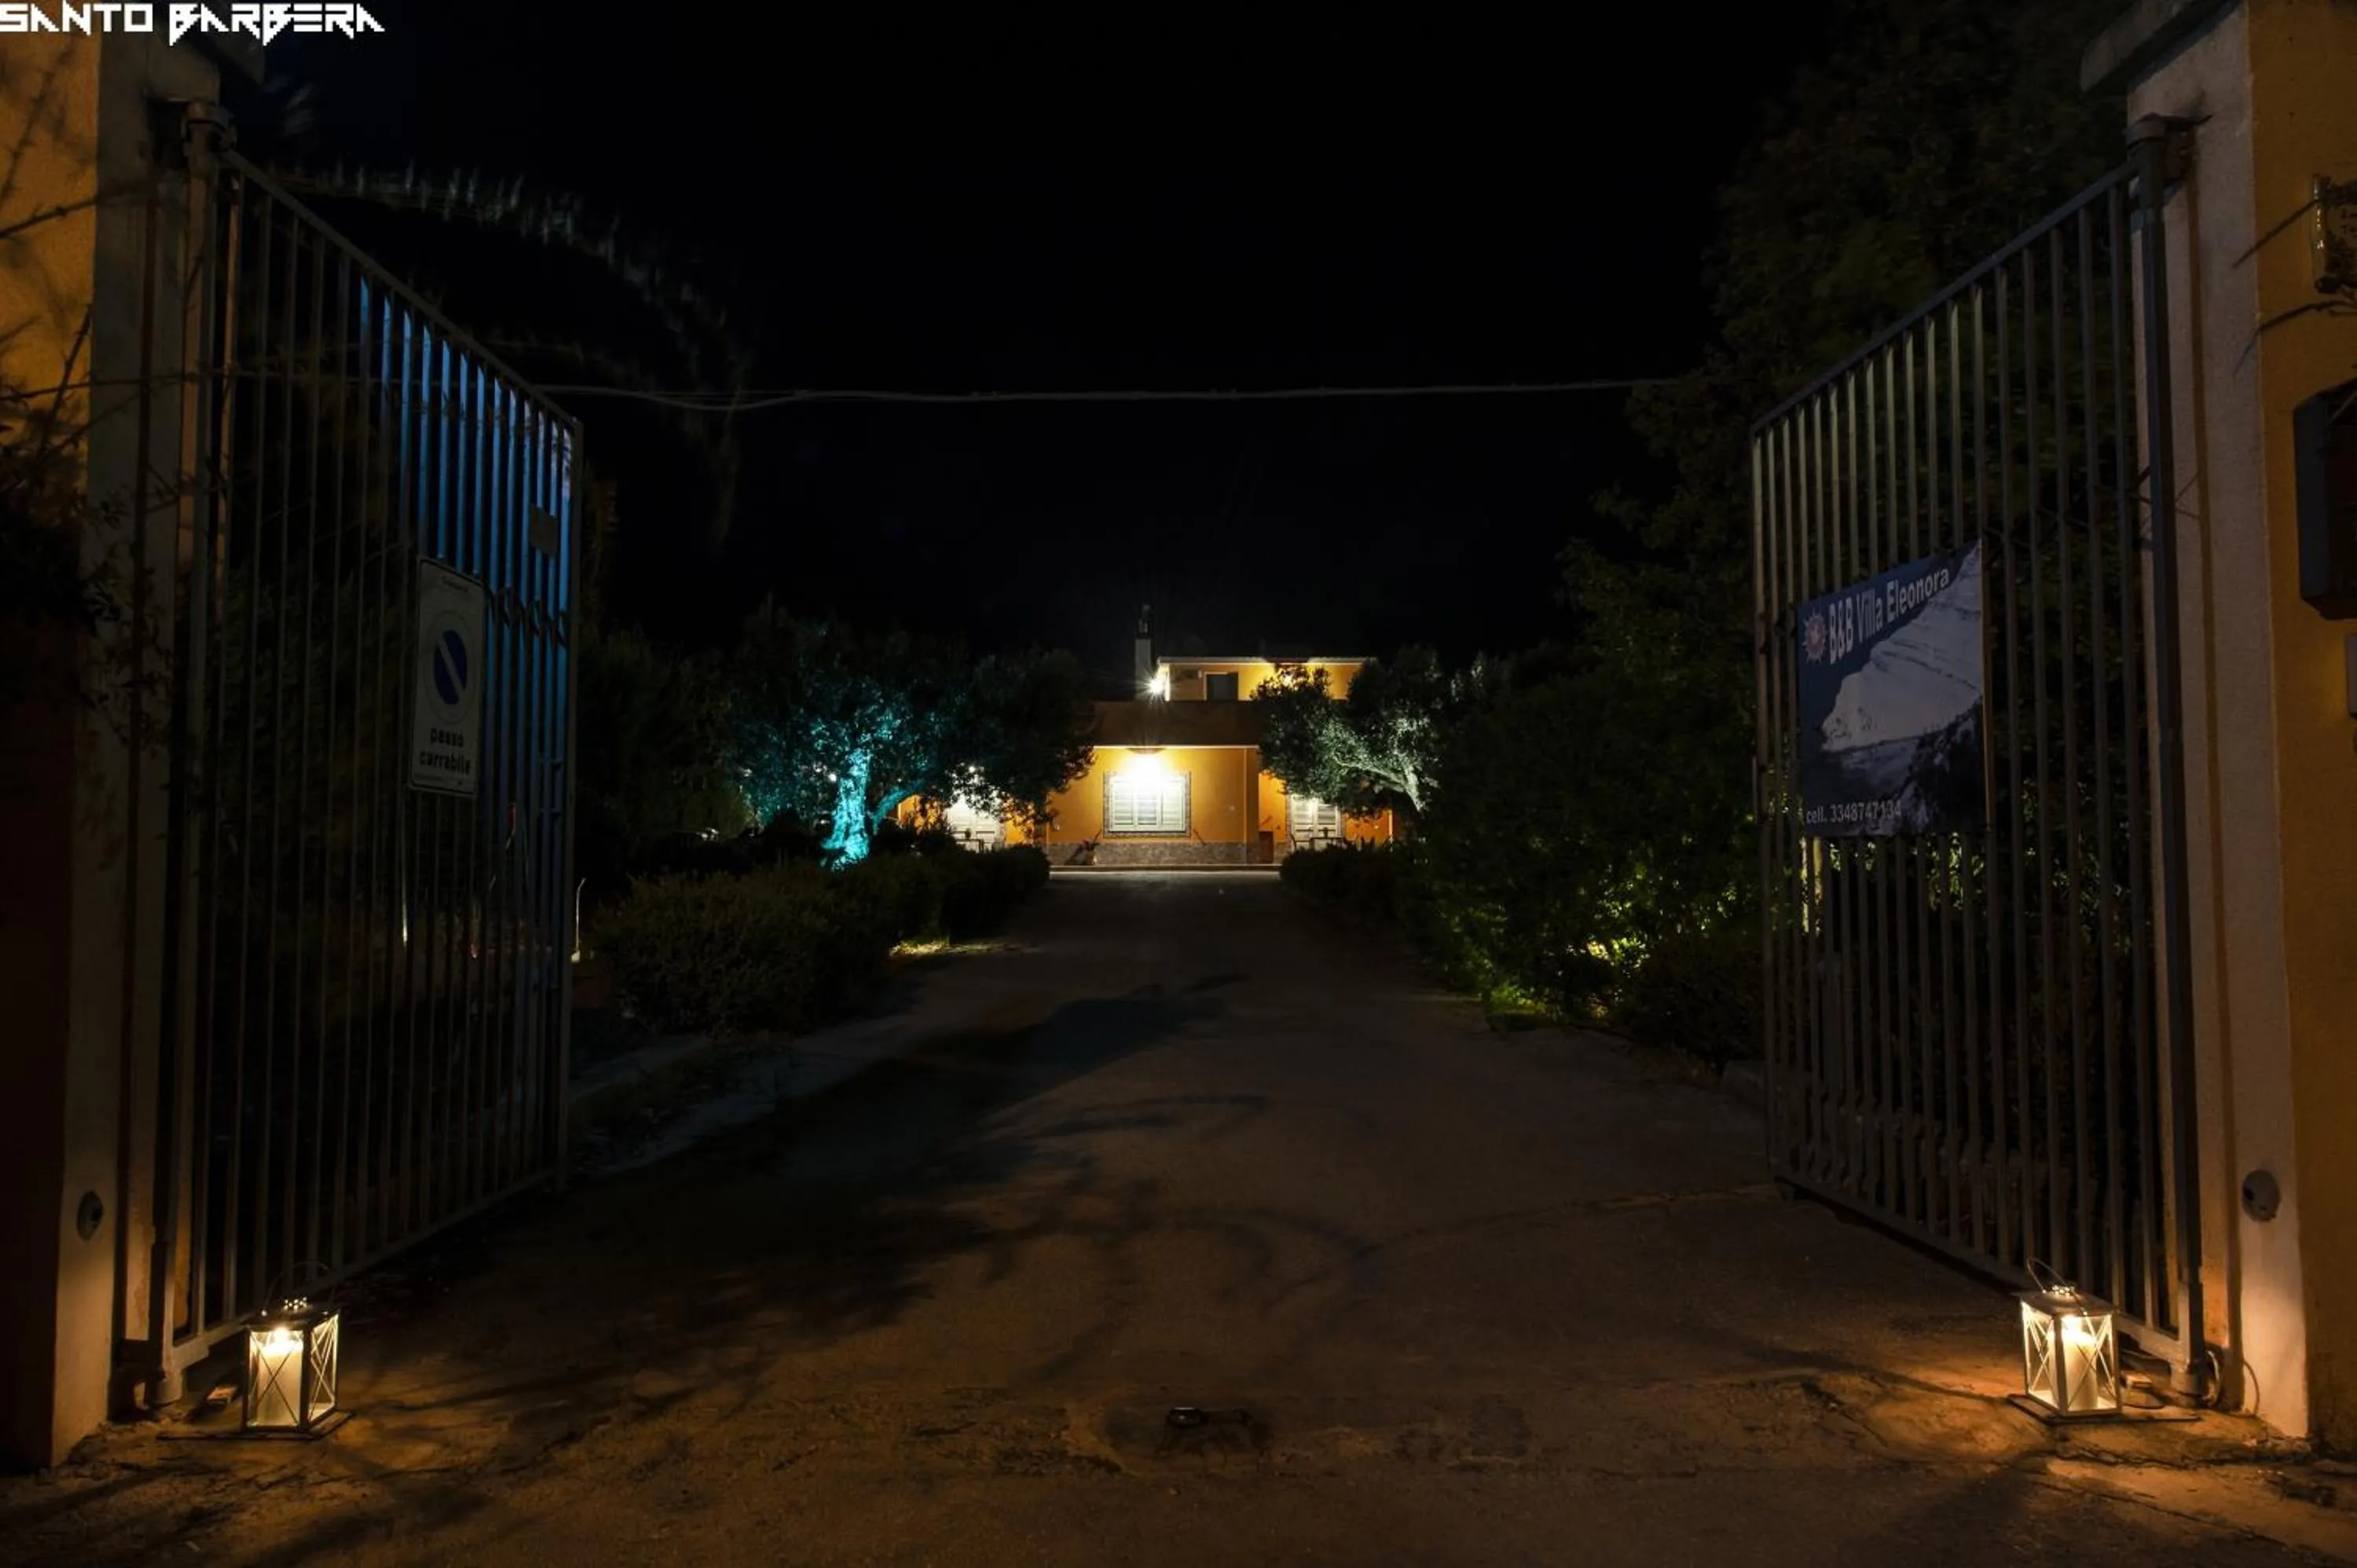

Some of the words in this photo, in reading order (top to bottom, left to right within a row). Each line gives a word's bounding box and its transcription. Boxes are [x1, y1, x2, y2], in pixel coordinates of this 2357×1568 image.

[1829, 596, 1853, 665] B&B
[1856, 588, 1883, 643] Villa
[1886, 568, 1948, 622] Eleonora
[420, 750, 471, 775] carrabile
[1806, 805, 1827, 823] cell.
